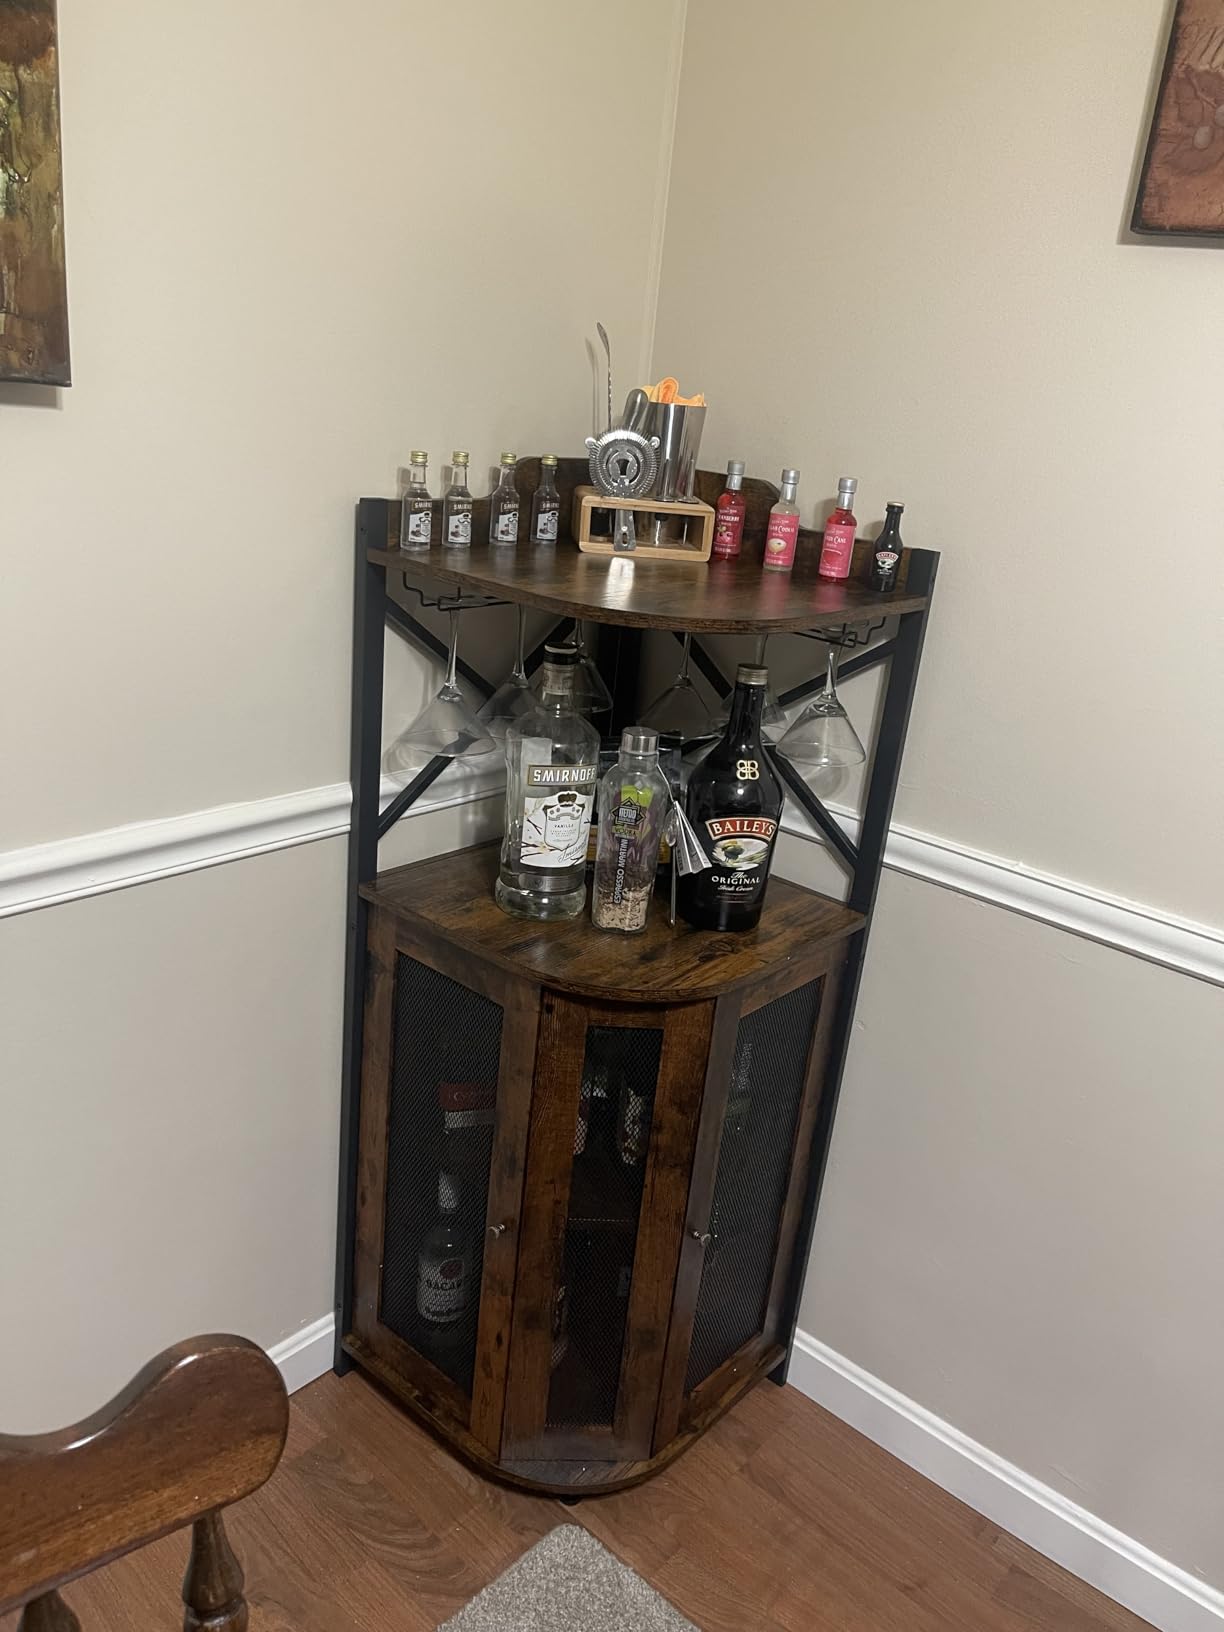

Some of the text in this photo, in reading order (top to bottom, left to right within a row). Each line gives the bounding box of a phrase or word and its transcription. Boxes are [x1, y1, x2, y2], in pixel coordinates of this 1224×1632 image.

[712, 821, 775, 836] BAILEYS
[617, 838, 629, 868] MARTINI
[613, 867, 625, 904] ESPRESSO
[711, 875, 760, 885] ORIGINAL
